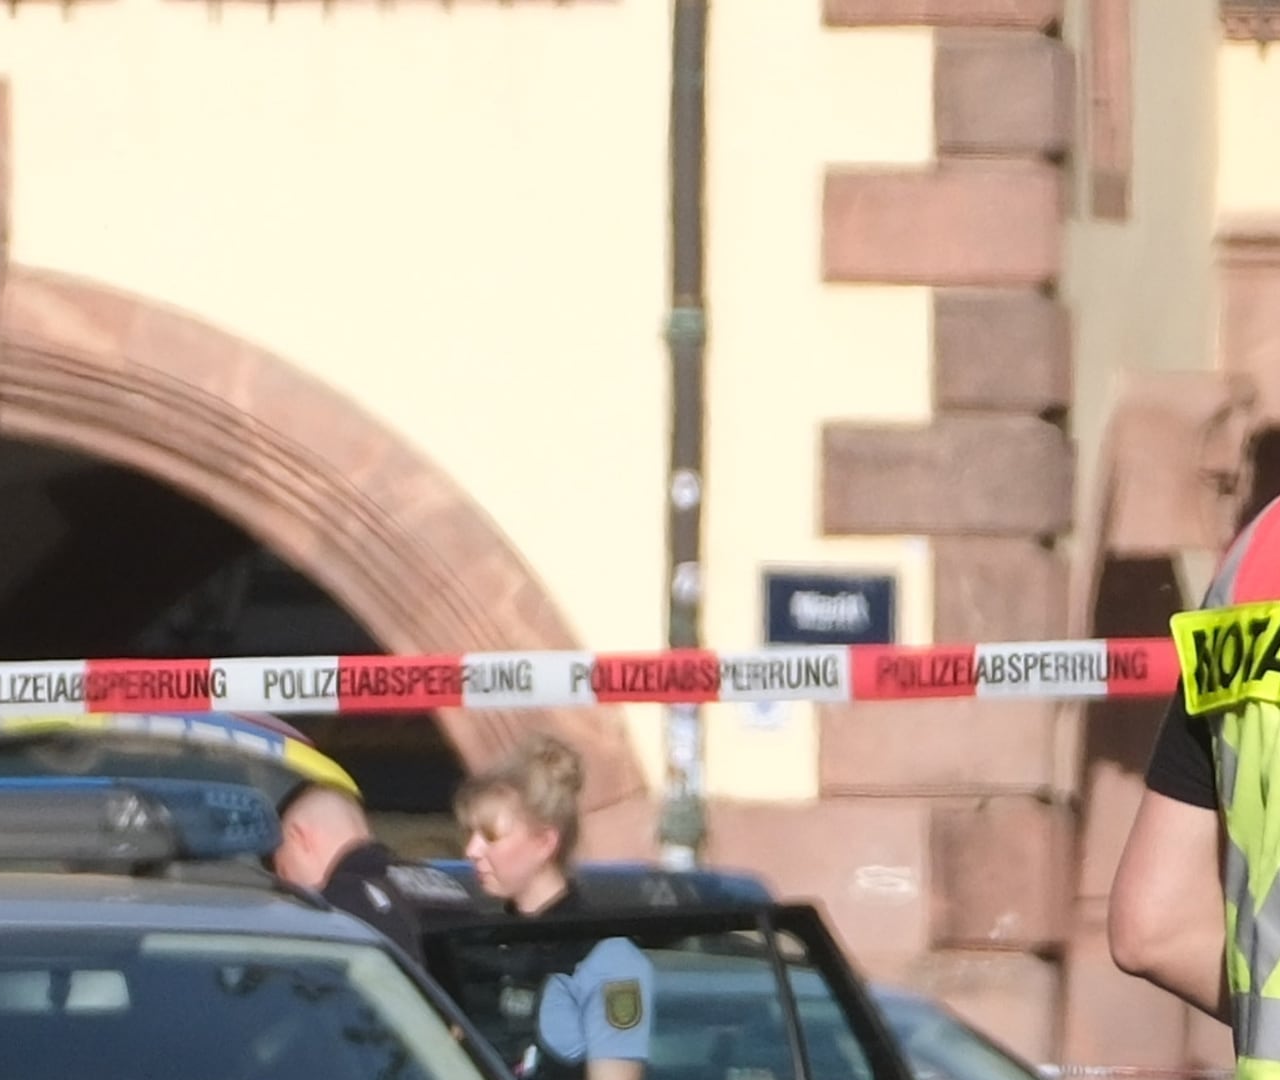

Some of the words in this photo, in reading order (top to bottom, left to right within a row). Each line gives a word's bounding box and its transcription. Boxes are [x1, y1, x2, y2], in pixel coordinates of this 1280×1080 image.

[263, 660, 534, 700] POLIZEIABSPERRUNG
[570, 655, 840, 693] POLIZEIABSPERRUNG
[874, 650, 1148, 690] POLIZEIABSPERRUNG
